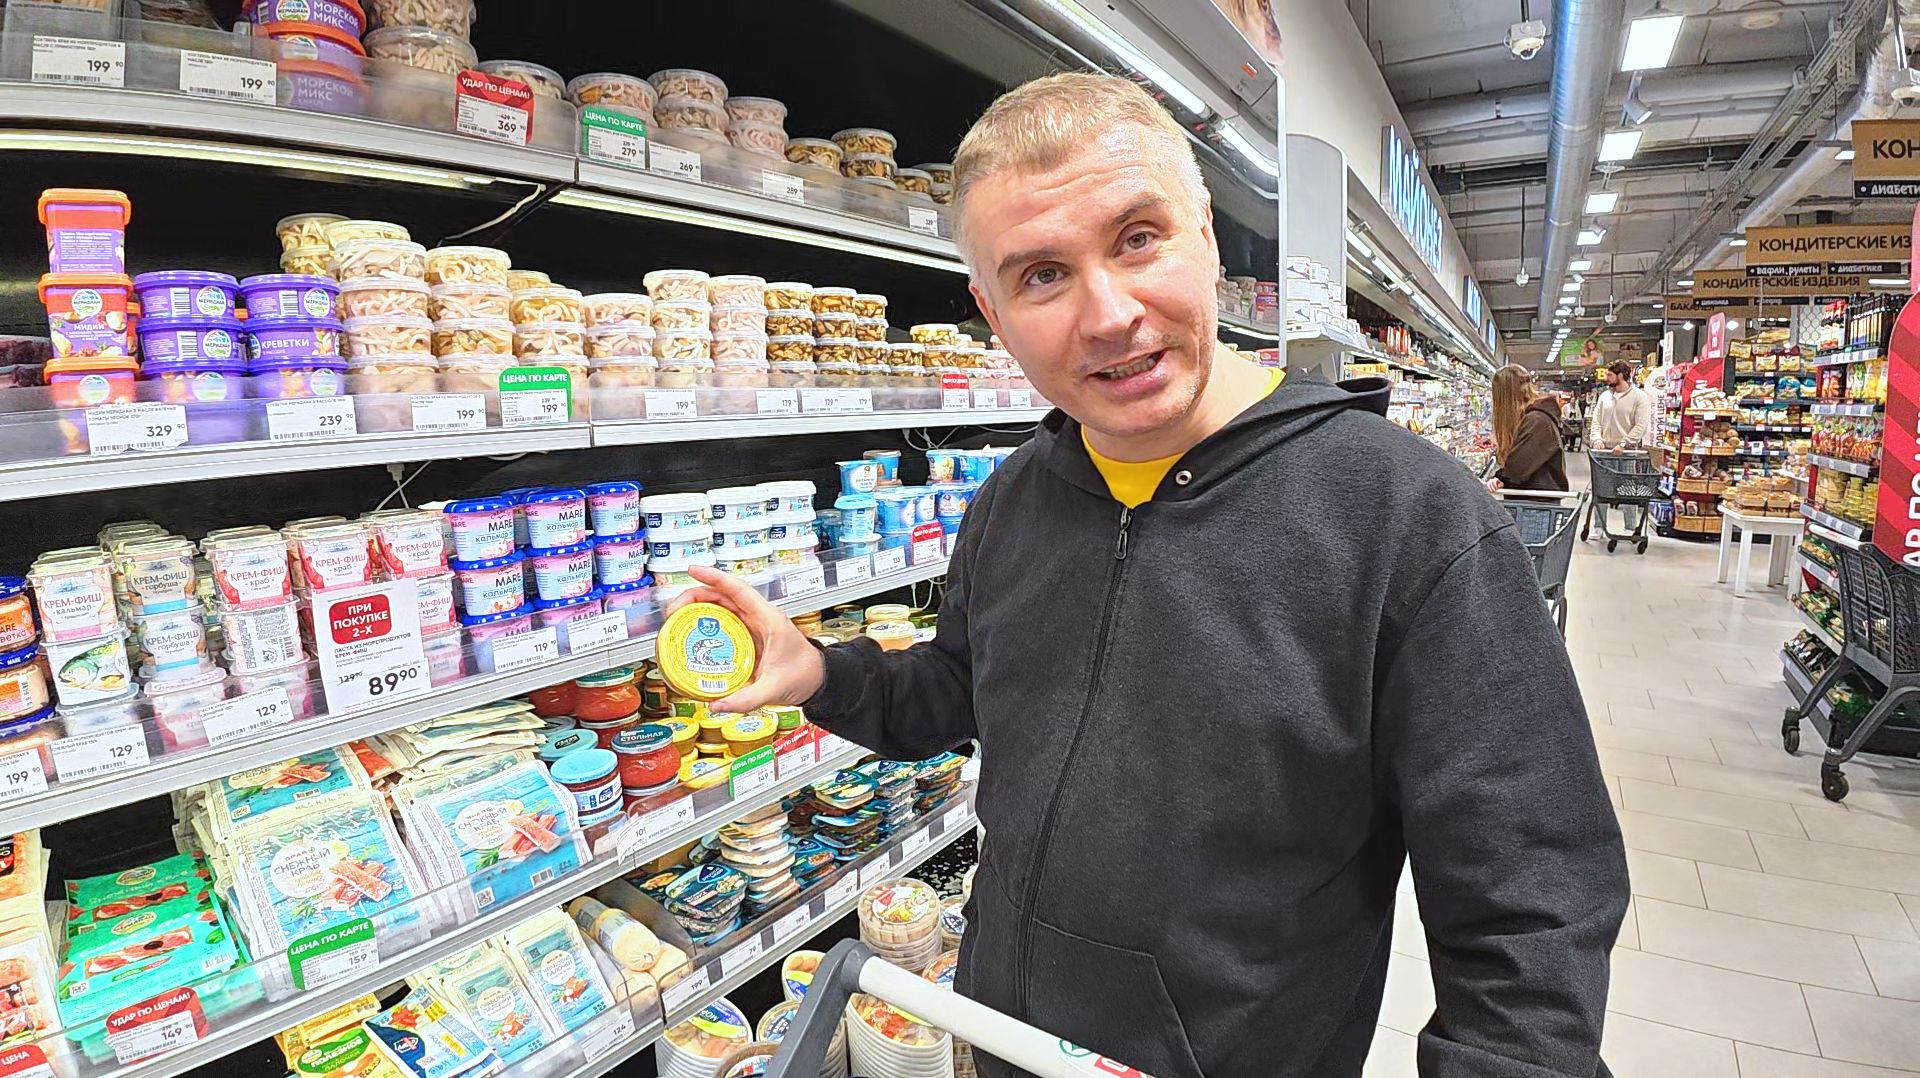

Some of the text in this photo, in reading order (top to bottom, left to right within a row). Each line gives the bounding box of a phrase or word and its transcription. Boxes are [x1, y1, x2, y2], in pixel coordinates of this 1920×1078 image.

[313, 11, 345, 29] МИКС
[87, 60, 111, 73] 199
[240, 77, 263, 90] 199
[461, 77, 530, 99] УДАР ПО ЦЕНАМ!
[497, 119, 517, 133] 369
[585, 111, 643, 131] ЦЕНА ПО КАРТЕ
[621, 147, 637, 158] 279
[1872, 138, 1920, 160] КОН
[679, 162, 694, 173] 269
[1758, 235, 1887, 253] КОНДИТЕРСКИЕ
[1702, 275, 1860, 291] КОНДИТЕРСКИЕ ИЗДЕЛИЯ
[261, 339, 310, 349] КРЕВЕТКИ
[503, 373, 568, 384] ЦЕНА ПО КАРТЕ
[541, 404, 558, 413] 199
[675, 401, 689, 409] 199
[319, 414, 343, 427] 239
[456, 409, 475, 420] 199
[146, 424, 172, 437] 329
[558, 508, 584, 522] MARE
[488, 519, 513, 533] MARE
[395, 539, 443, 554] КРЕМ-ФИШ
[315, 553, 367, 568] КРЕМ-ФИШ
[412, 549, 430, 559] краб
[229, 565, 285, 582] КРЕМ-ФИШ
[333, 563, 353, 574] краб
[568, 560, 591, 573] MARE
[133, 570, 188, 586] КРЕМ-ФИШ
[249, 577, 270, 588] краб
[495, 573, 521, 588] MARE
[43, 591, 102, 609] КРЕМ-ФИШ
[347, 602, 372, 616] ПРИ
[333, 610, 389, 631] ПОКУПКЕ
[602, 624, 618, 635] 149
[145, 628, 200, 646] КРЕМ-ФИШ
[534, 643, 548, 653] 119
[368, 672, 399, 696] 89
[255, 703, 277, 718] 129
[109, 744, 133, 758] 129
[774, 745, 784, 754] ДАР
[5, 770, 29, 785] 199
[677, 809, 687, 818] 99
[290, 939, 320, 956] ЦЕНА
[320, 933, 338, 945] ПО
[339, 921, 369, 938] КАРТЕ
[348, 953, 368, 966] 159
[691, 979, 703, 991] 199
[111, 991, 191, 1027] УДАР ПО ЦЕНАМ!
[161, 1027, 183, 1041] 149
[1, 1050, 31, 1065] ЦЕНА
